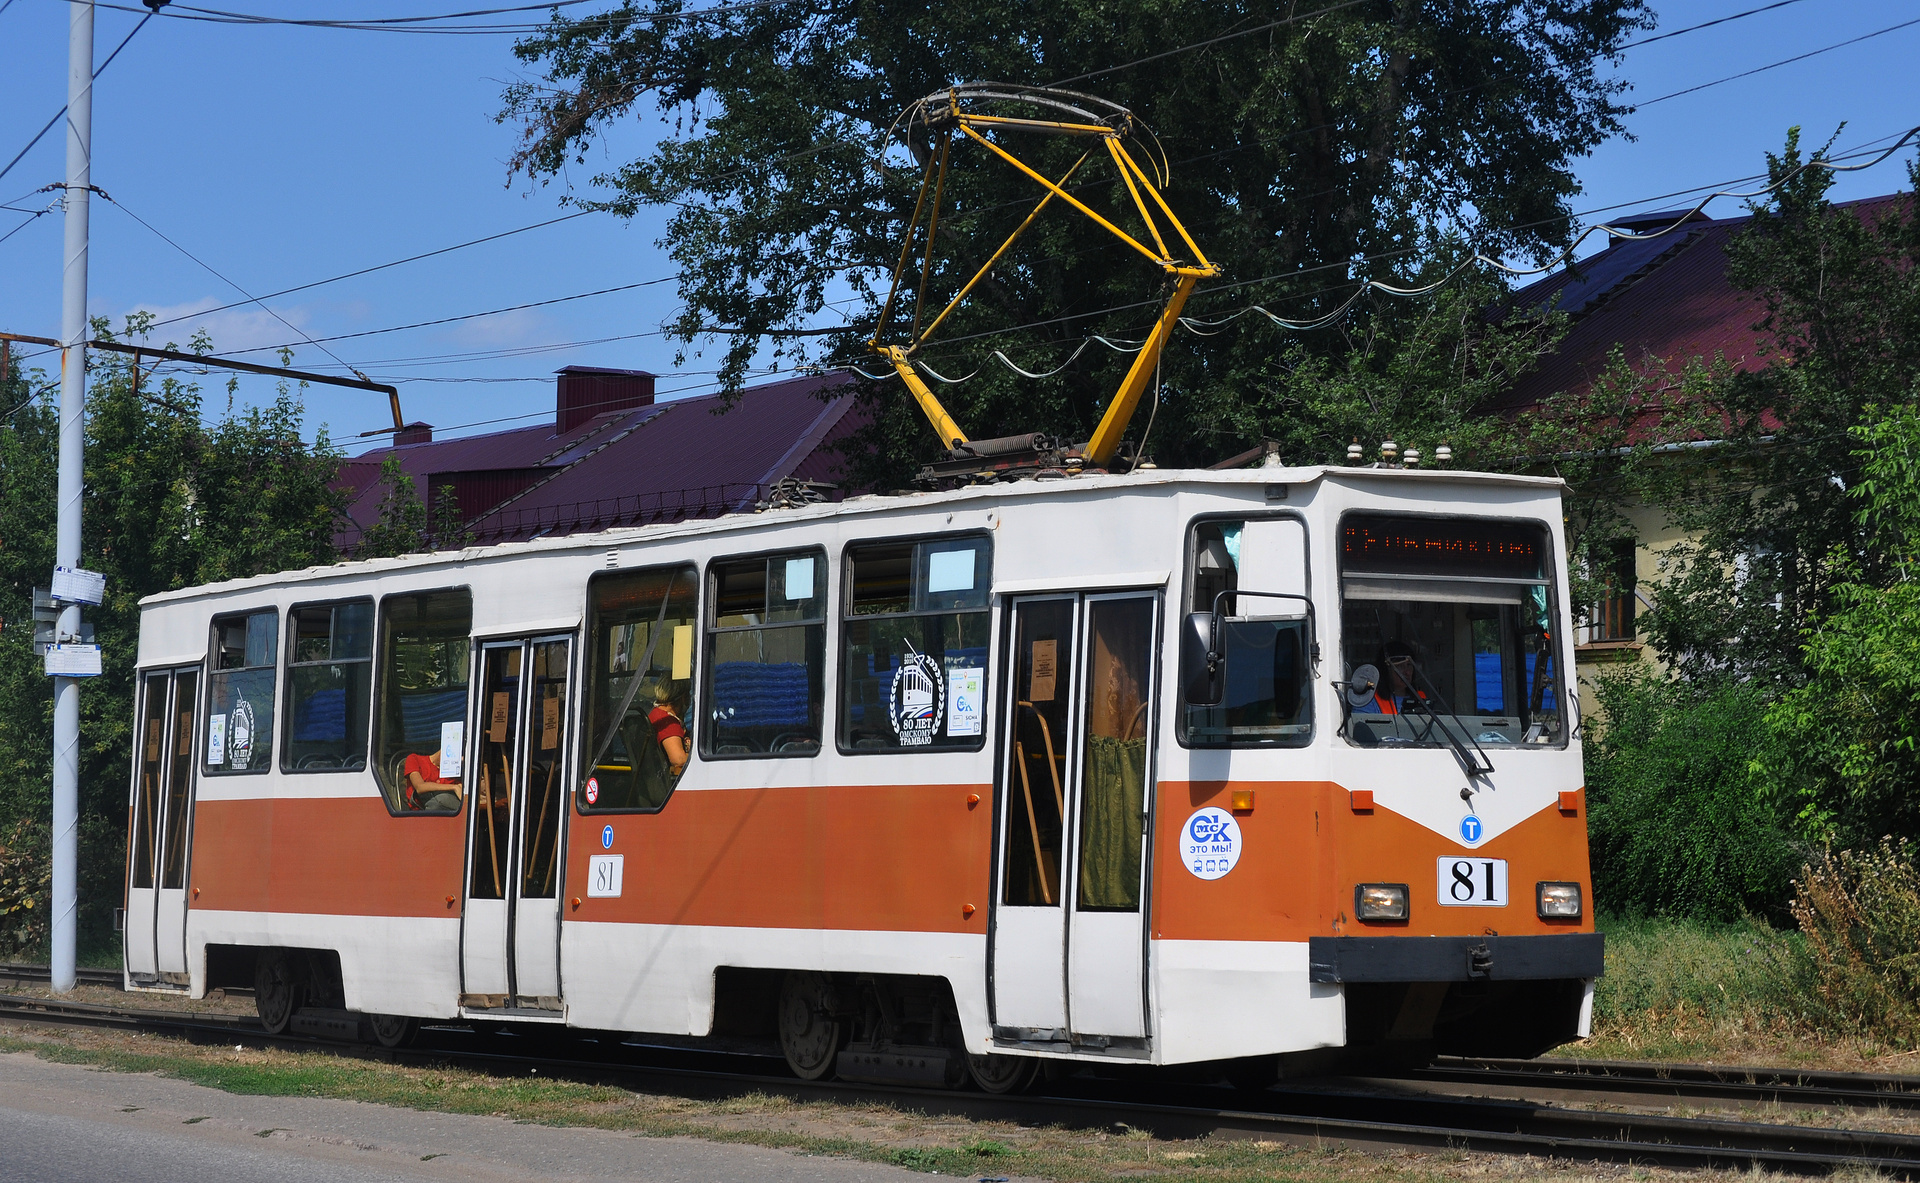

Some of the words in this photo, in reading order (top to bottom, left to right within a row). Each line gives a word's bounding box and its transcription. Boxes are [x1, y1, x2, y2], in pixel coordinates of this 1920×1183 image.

[903, 718, 914, 730] 80
[914, 717, 933, 729] ЛЕТ
[899, 729, 932, 737] ОМСКОМУ
[899, 736, 932, 745] ТРАМВАЮ
[1190, 845, 1208, 853] ЭТО
[1211, 842, 1232, 853] МЫ!
[597, 862, 613, 891] 81
[1450, 860, 1498, 902] 81
